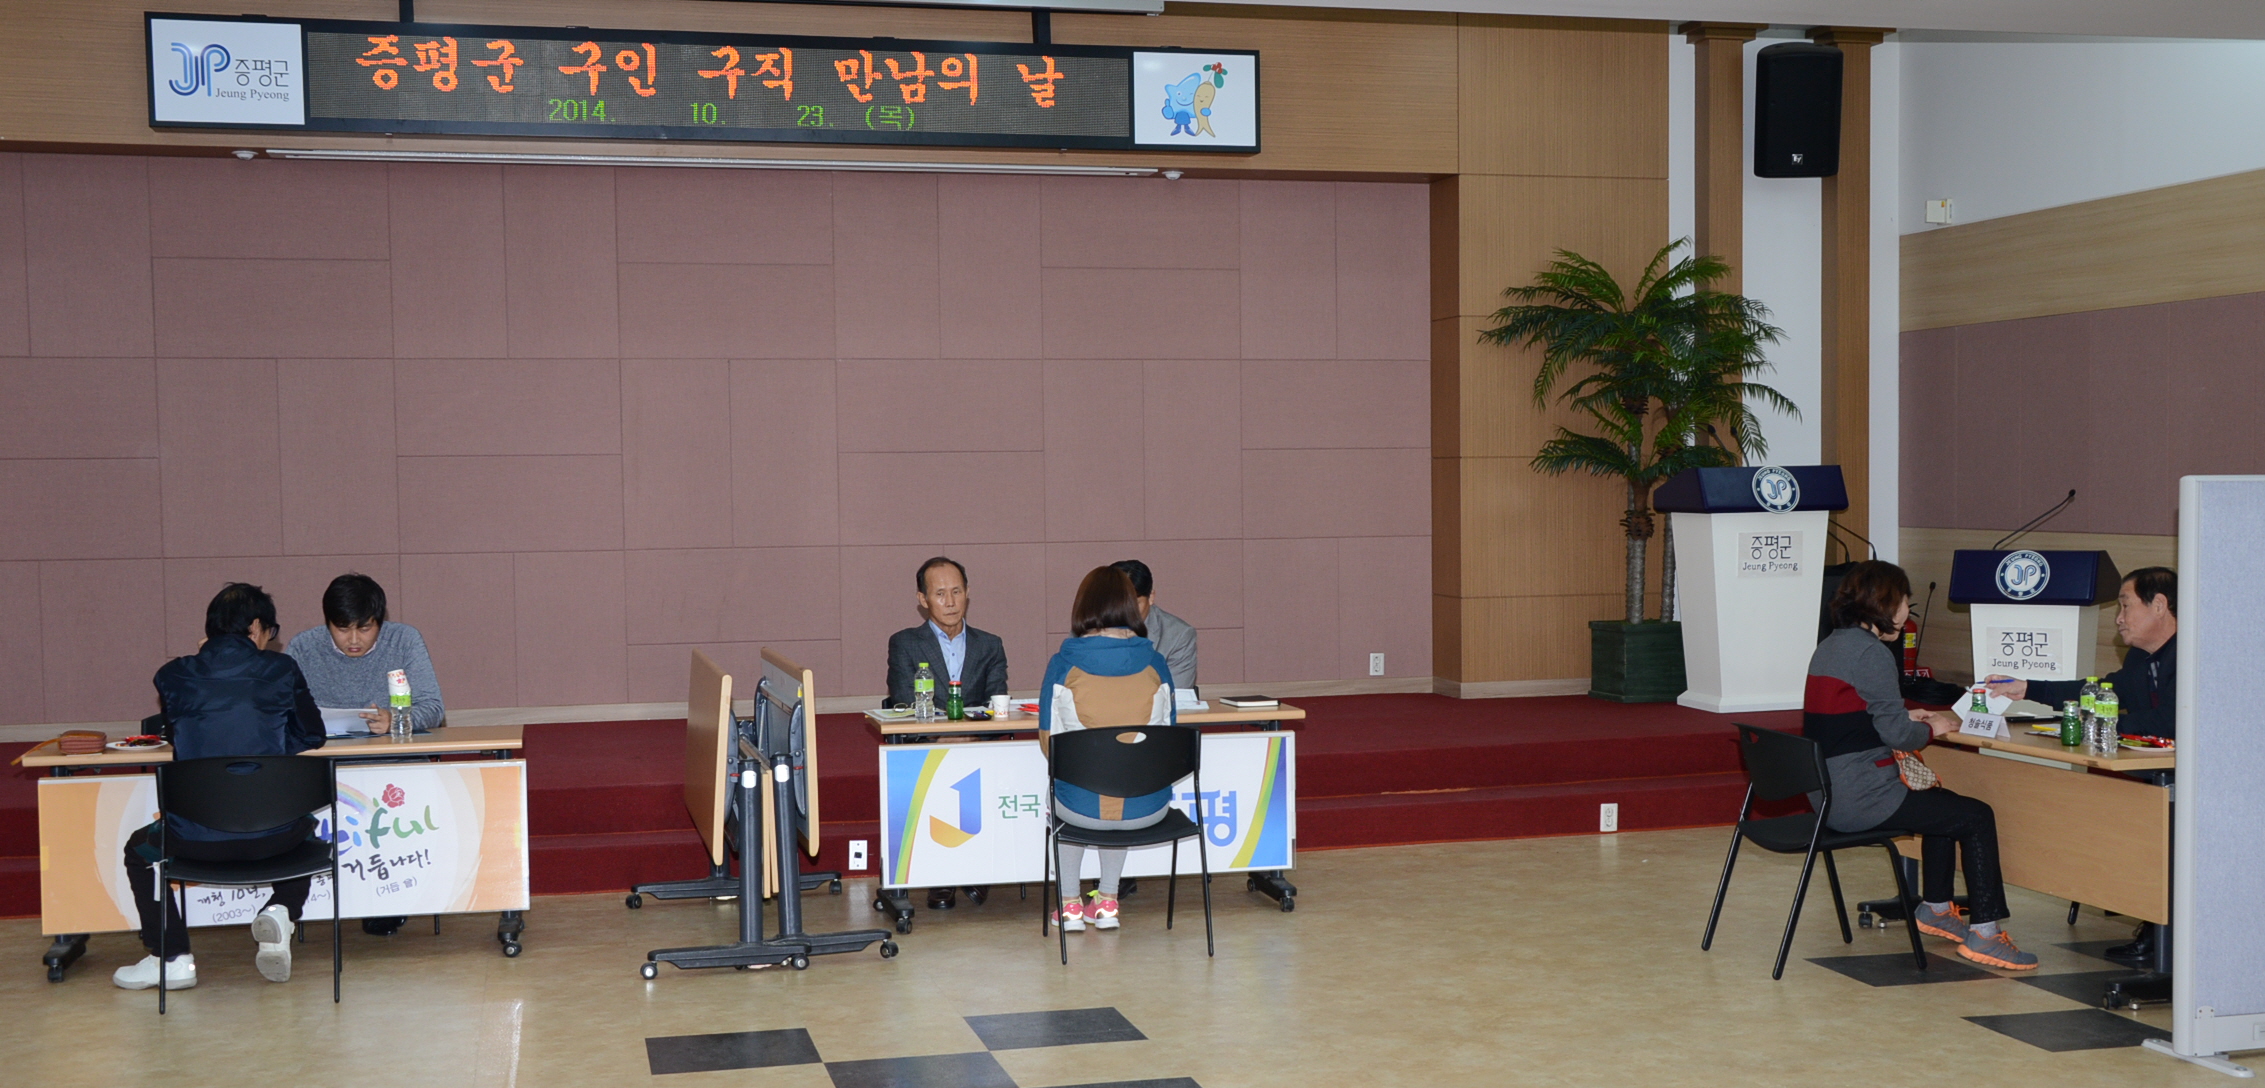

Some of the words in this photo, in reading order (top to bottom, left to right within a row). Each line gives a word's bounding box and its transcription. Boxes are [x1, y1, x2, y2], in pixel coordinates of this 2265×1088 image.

[234, 58, 290, 88] 증평군
[356, 34, 525, 93] 증평군
[558, 40, 657, 97] 구인
[697, 45, 794, 101] 구직
[834, 49, 979, 106] 만남의
[1016, 55, 1065, 108] 날
[215, 87, 247, 101] Jeung
[250, 88, 290, 103] Pyeong
[549, 98, 617, 123] 2014.
[691, 102, 727, 125] 10.
[797, 104, 834, 128] 23.
[865, 106, 915, 130] (목)
[1750, 535, 1792, 560] 증평군
[1742, 561, 1767, 573] Jeung
[1768, 561, 1799, 572] Pyeong
[2000, 631, 2048, 657] 증평군
[1991, 658, 2020, 670] Jeung
[2021, 658, 2057, 671] Pyeong
[997, 794, 1041, 820] 전국
[1172, 789, 1237, 848] 평
[197, 891, 226, 907] 개청
[341, 848, 432, 881] 거듭나다!
